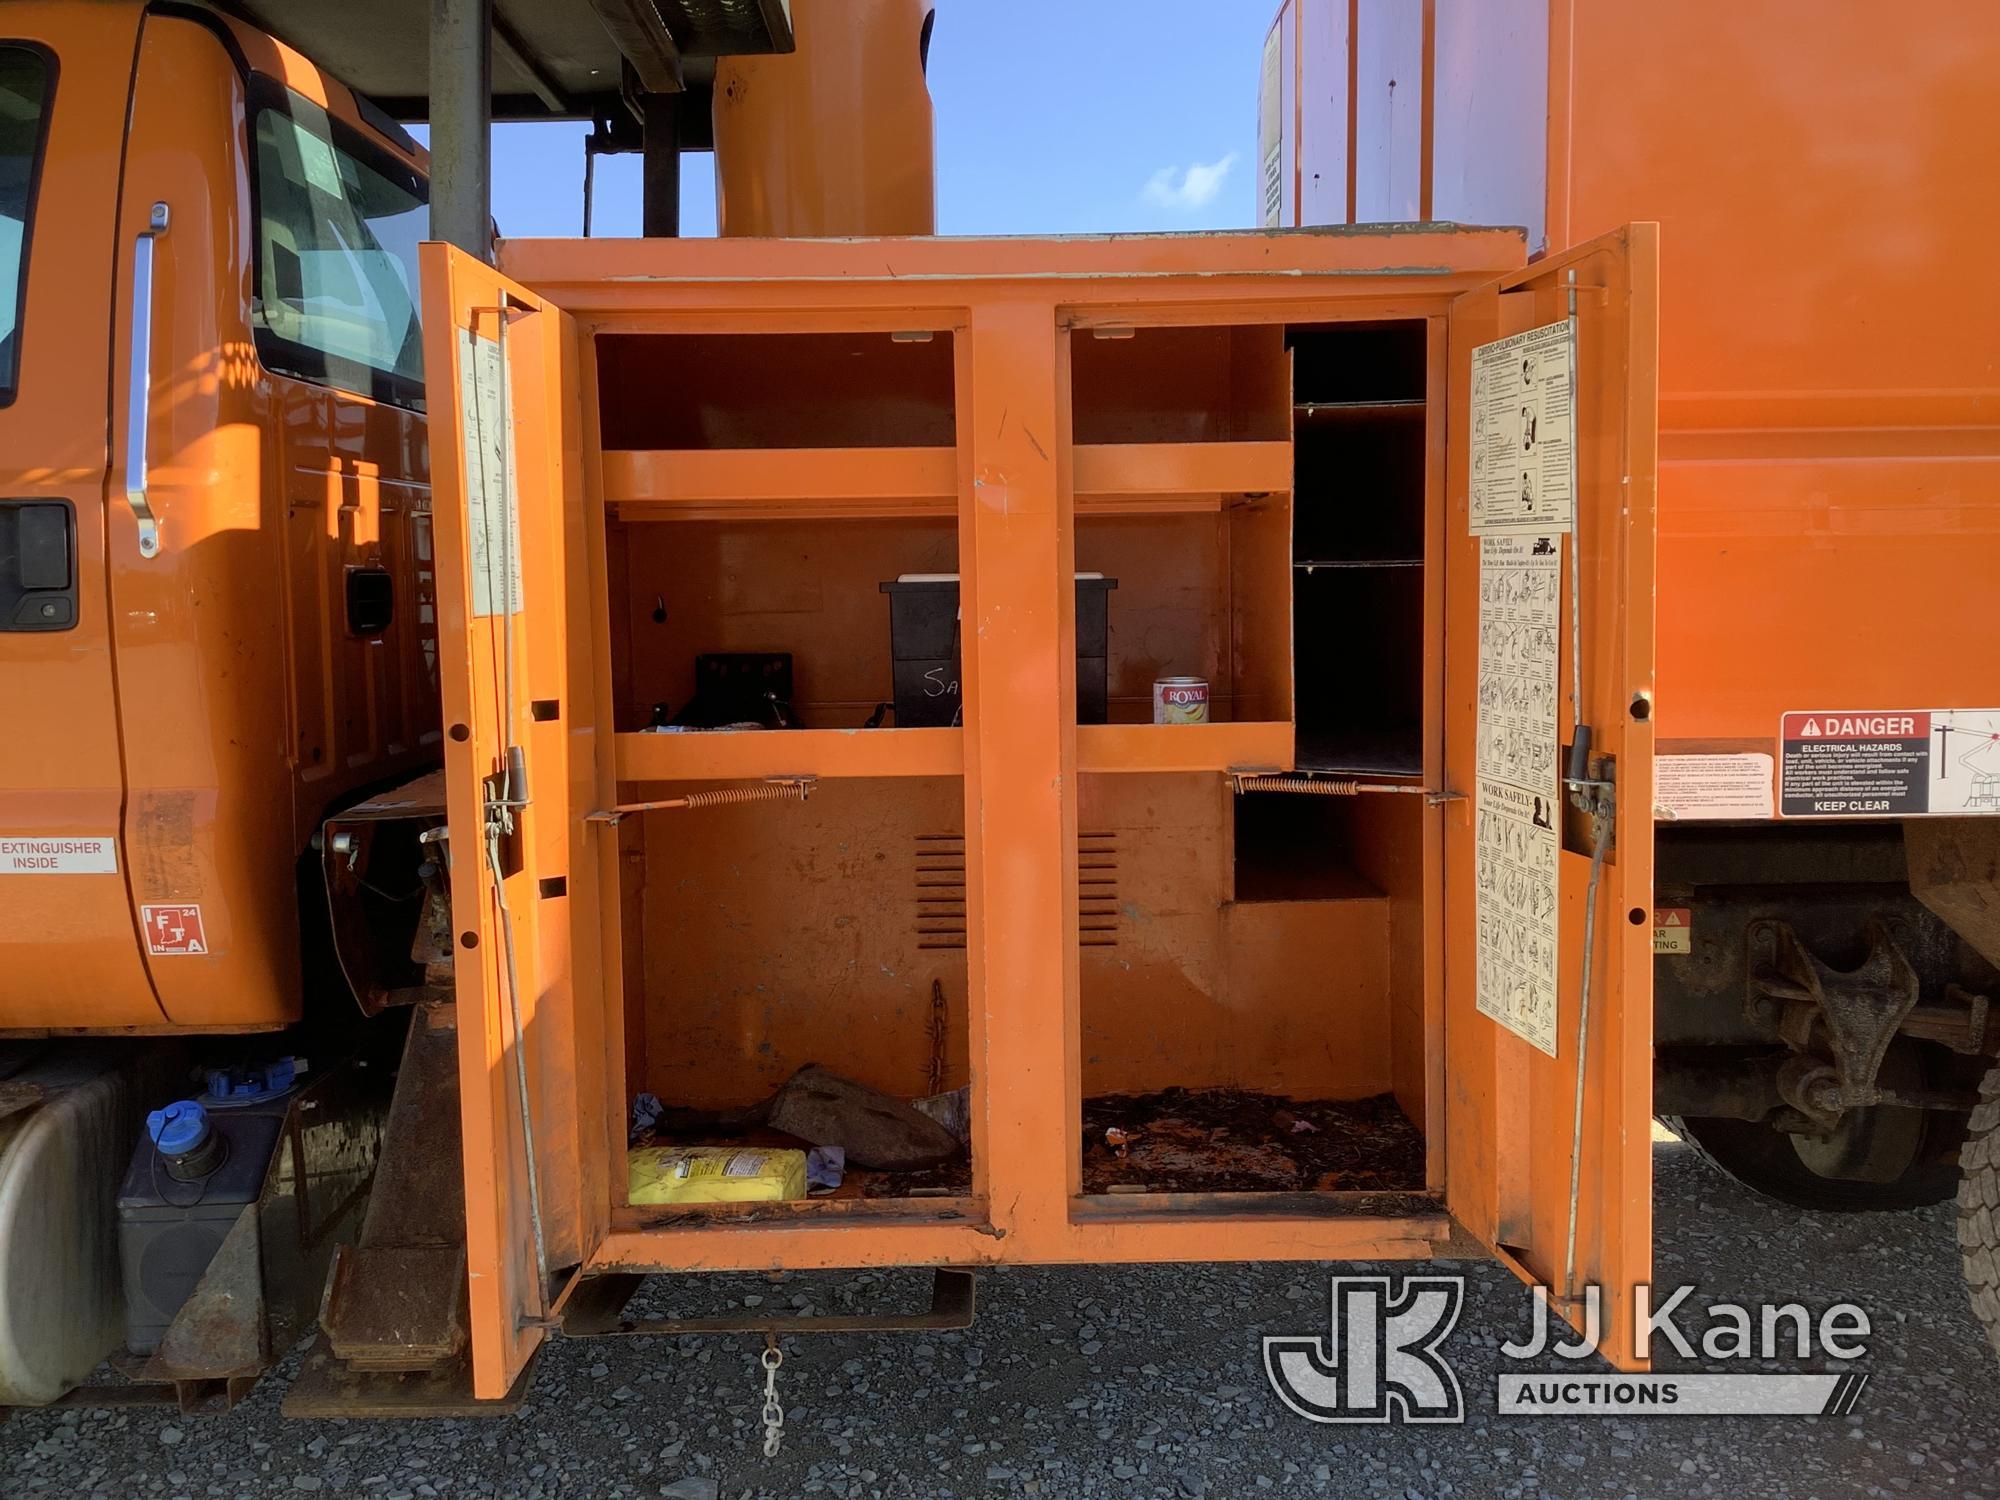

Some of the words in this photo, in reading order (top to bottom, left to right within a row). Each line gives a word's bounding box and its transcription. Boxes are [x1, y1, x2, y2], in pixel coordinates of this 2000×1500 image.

[1170, 690, 1204, 703] ROYAL
[1826, 717, 1914, 736] DANGER
[1802, 744, 1856, 752] ELECTRICAL
[1482, 782, 1503, 799] WORK
[1815, 802, 1847, 811] KEEP
[1849, 801, 1890, 810] CLEAR
[2, 842, 101, 854] EXTINGUISHER
[13, 858, 59, 868] INSIDE
[182, 909, 196, 917] 24
